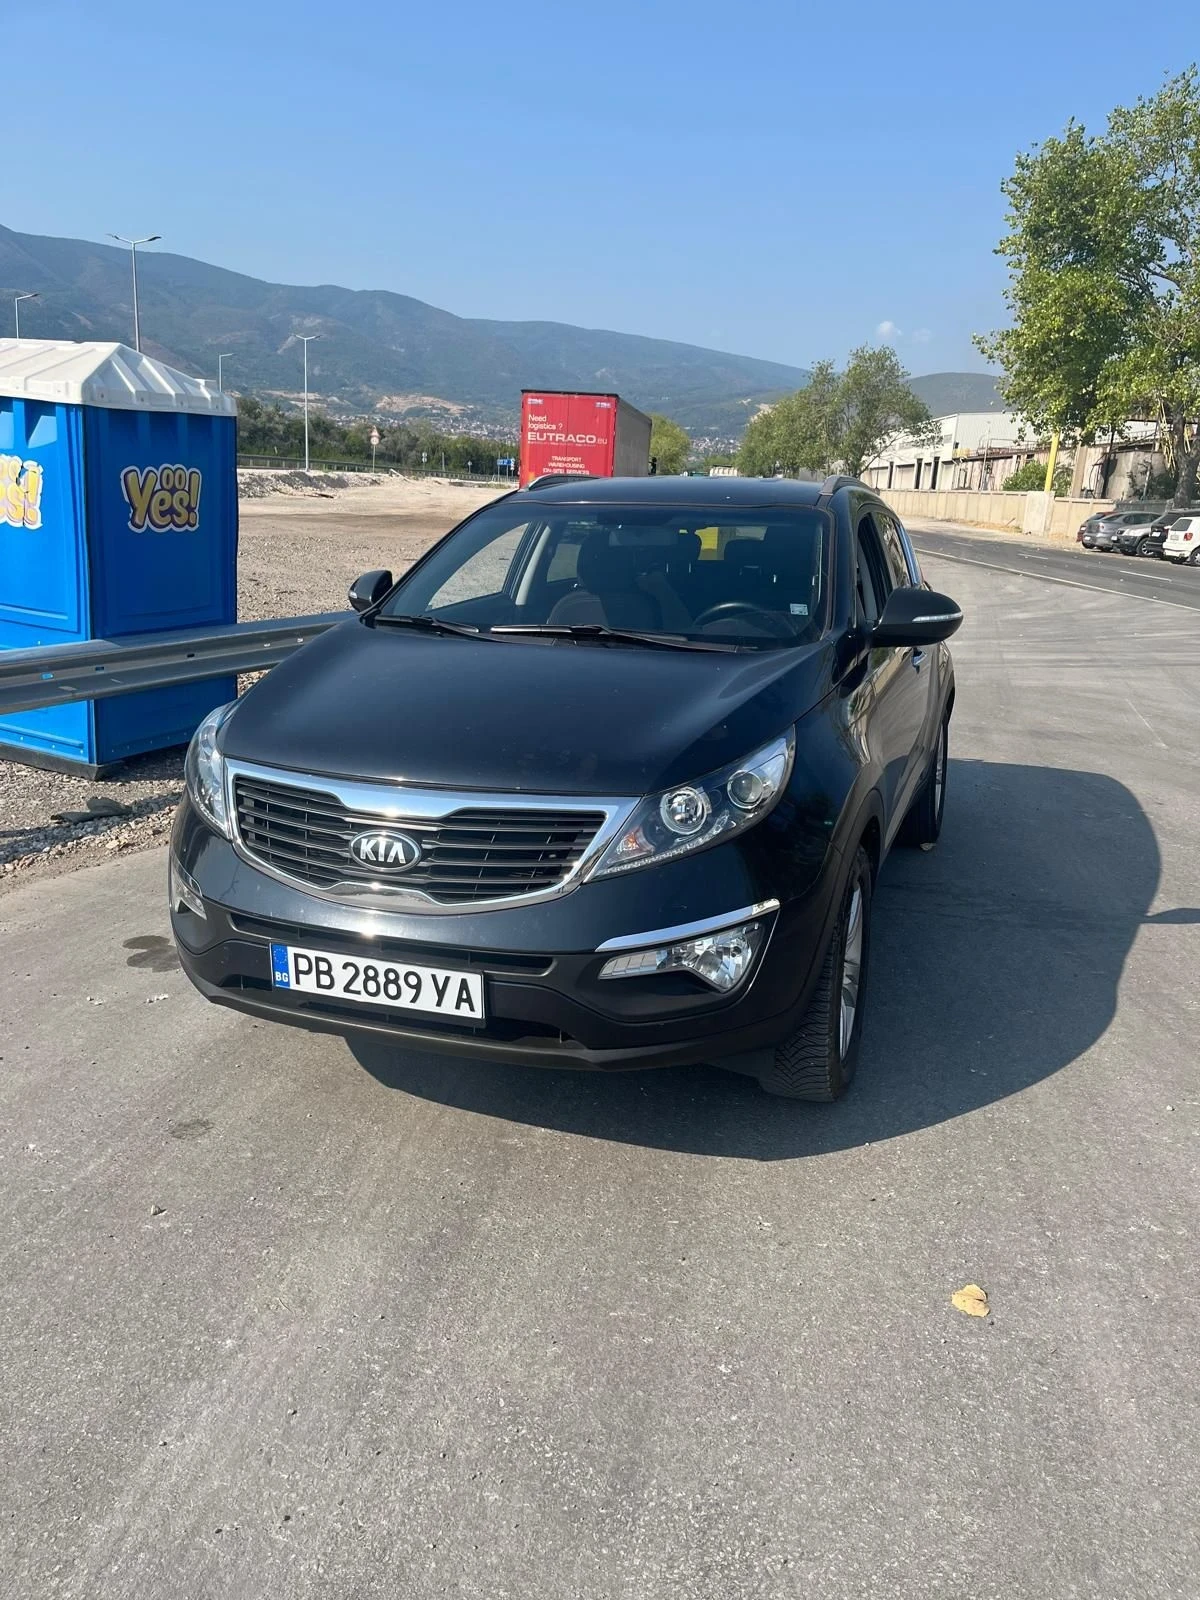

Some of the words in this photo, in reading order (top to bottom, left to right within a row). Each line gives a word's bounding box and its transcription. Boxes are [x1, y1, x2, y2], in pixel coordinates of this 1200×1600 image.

[528, 414, 547, 422] Need
[528, 422, 557, 431] logistics
[360, 838, 406, 864] KIA
[275, 971, 289, 982] BG
[293, 952, 335, 990] PB
[342, 962, 422, 1004] 2889
[431, 974, 475, 1012] YA
